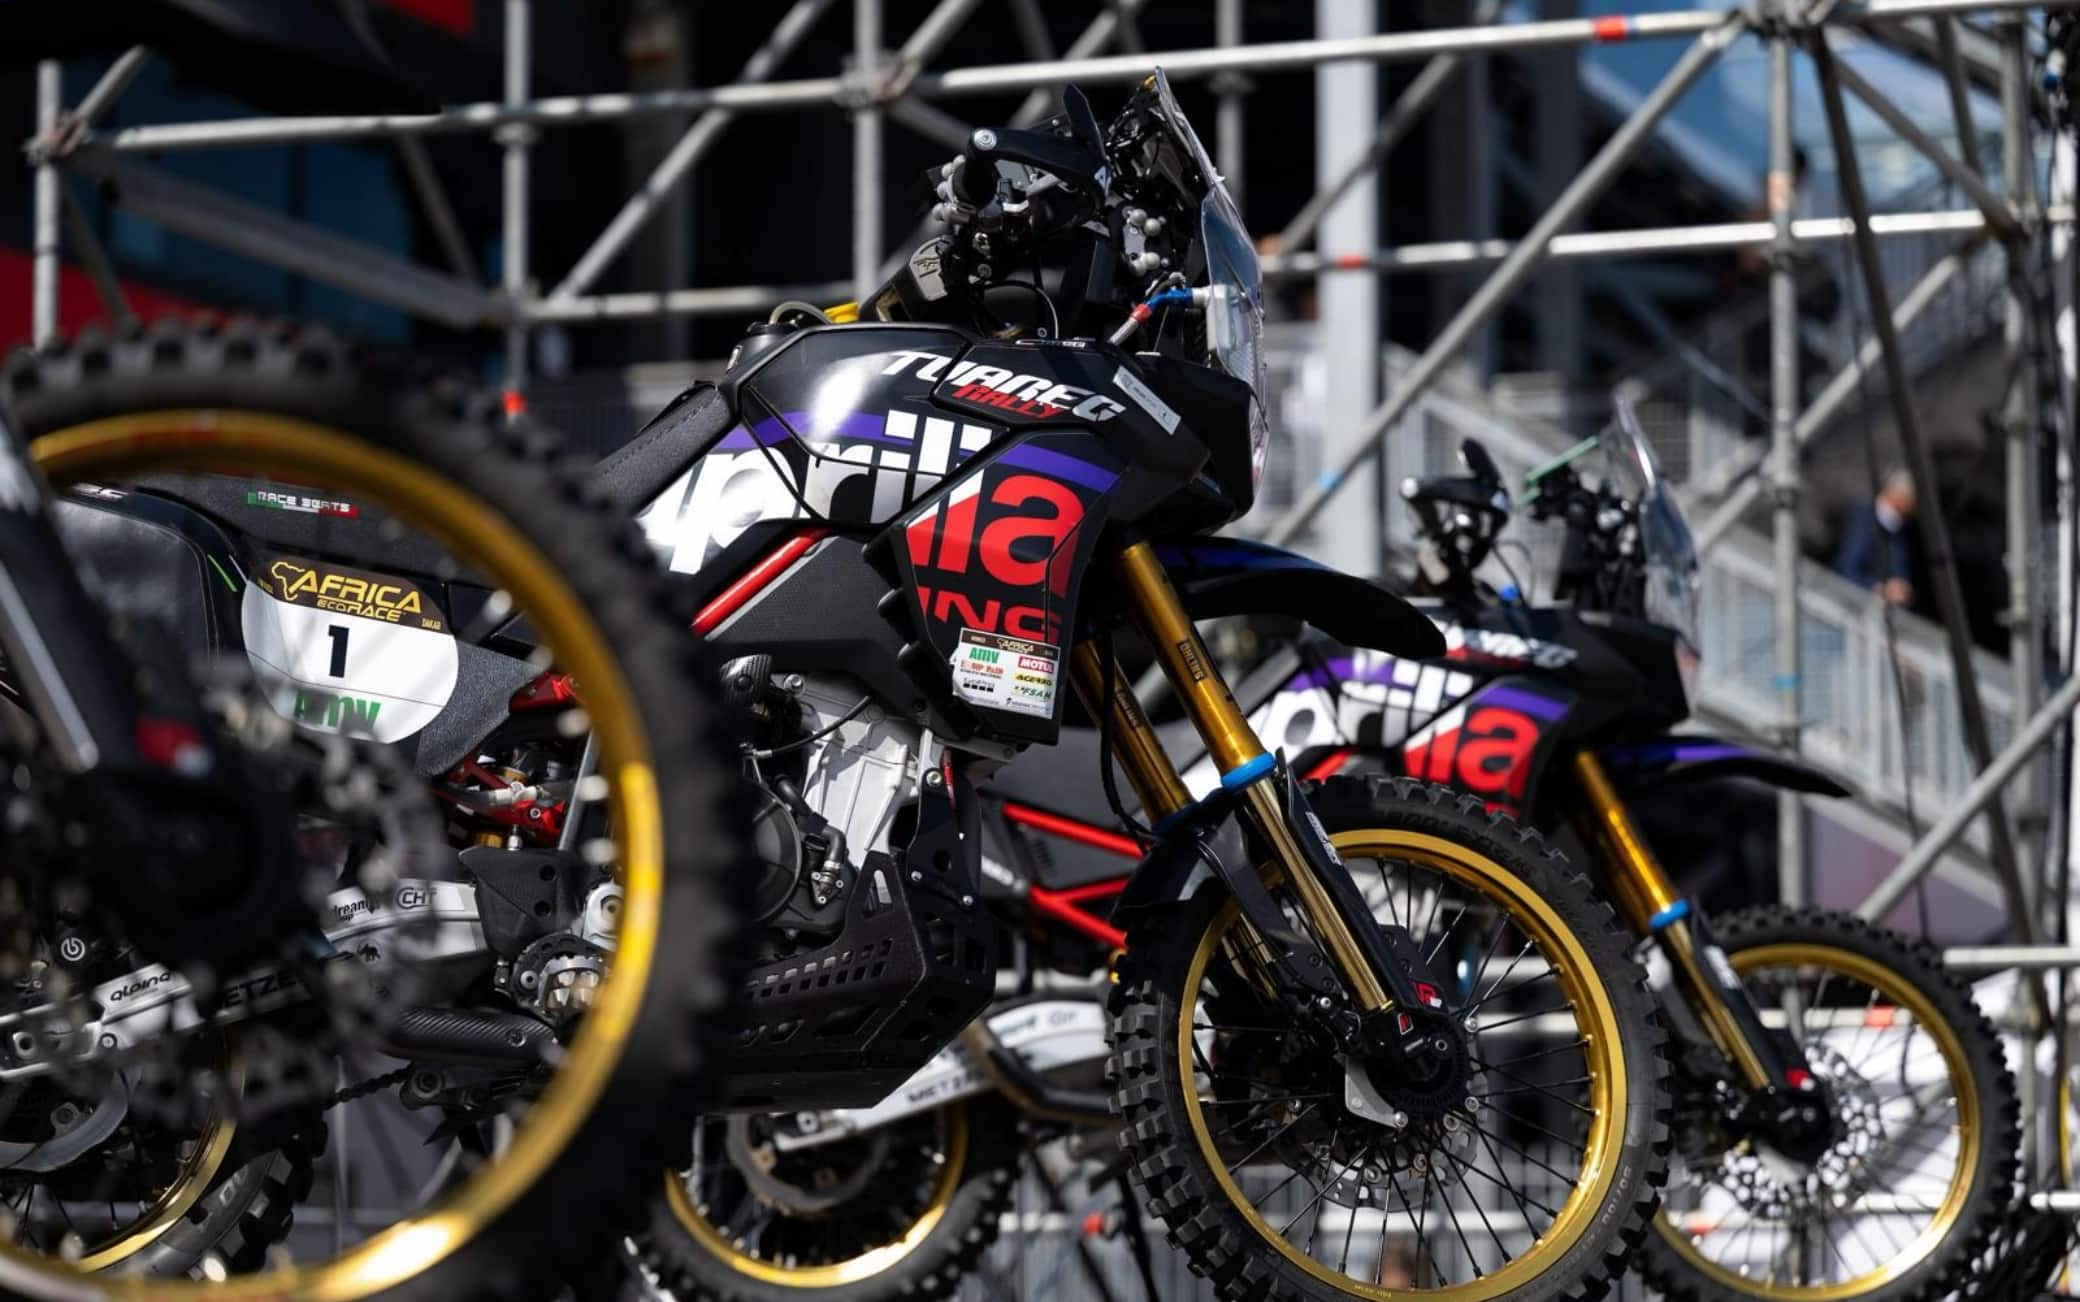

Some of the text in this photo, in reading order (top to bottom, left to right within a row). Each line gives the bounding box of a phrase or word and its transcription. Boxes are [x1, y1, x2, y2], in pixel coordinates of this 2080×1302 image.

[881, 351, 1127, 422] TUAREG
[951, 383, 1066, 419] RALLY
[257, 491, 297, 506] RACE
[288, 569, 422, 614] AFRICA
[328, 624, 350, 678] 1
